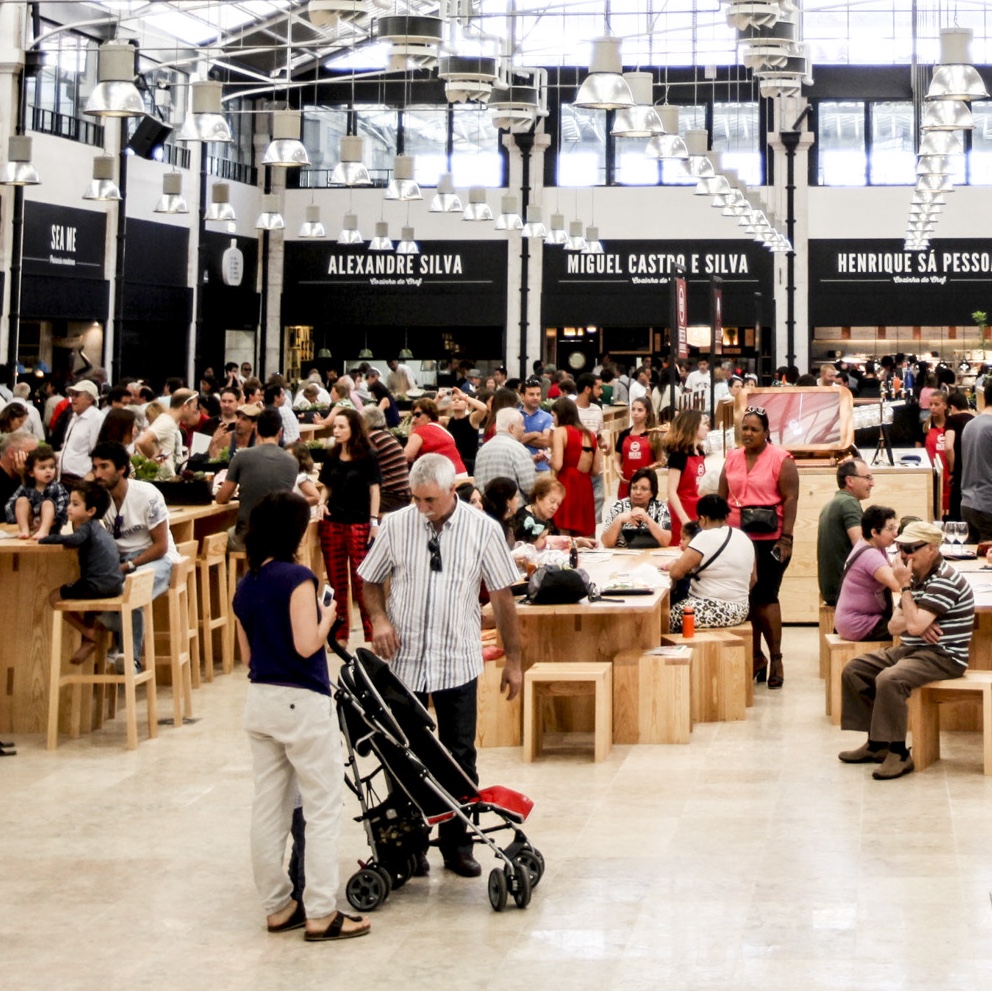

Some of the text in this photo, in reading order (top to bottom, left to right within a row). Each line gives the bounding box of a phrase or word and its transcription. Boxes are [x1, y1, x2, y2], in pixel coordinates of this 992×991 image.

[51, 224, 77, 252] SEA ME
[328, 255, 462, 274] ALEXANDRE SILVA
[567, 254, 622, 273] MIGUEL
[691, 254, 699, 273] E
[705, 254, 748, 273] SILVA
[838, 253, 912, 273] HENRIQUE
[917, 249, 937, 272] SÁ
